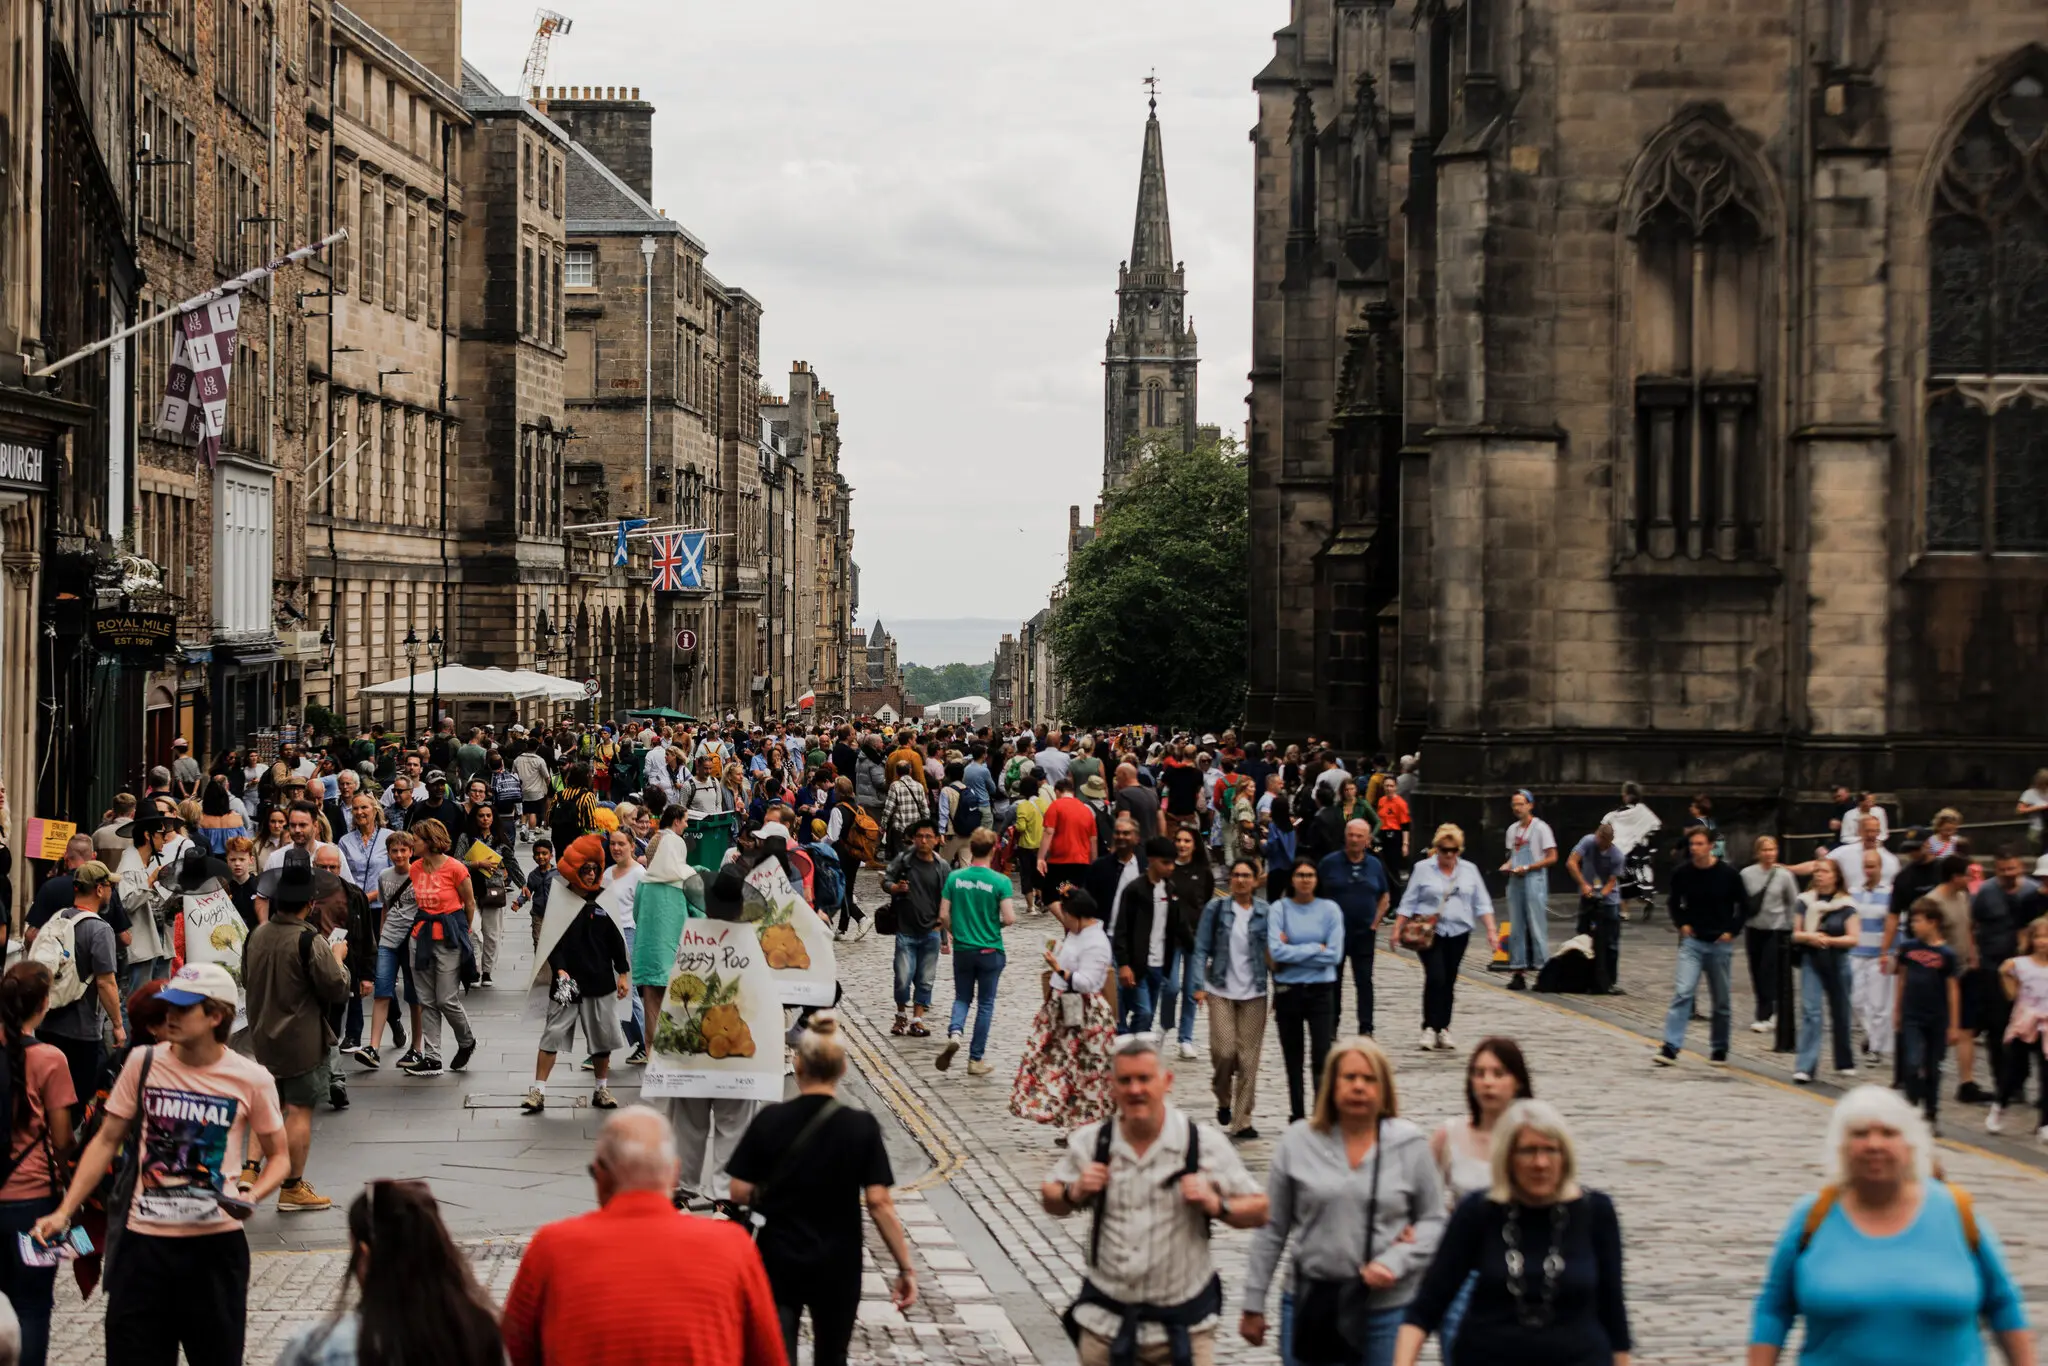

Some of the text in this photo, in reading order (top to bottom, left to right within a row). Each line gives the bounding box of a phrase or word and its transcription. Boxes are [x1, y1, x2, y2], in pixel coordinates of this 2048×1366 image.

[194, 344, 210, 363] H
[204, 376, 215, 386] 19
[204, 385, 218, 396] 85
[97, 619, 172, 632] ROYAL MILE
[135, 637, 153, 646] 1991
[585, 682, 598, 690] 20
[684, 928, 730, 947] Aha!
[723, 946, 750, 970] Poo
[145, 1096, 231, 1127] LIMINAL
